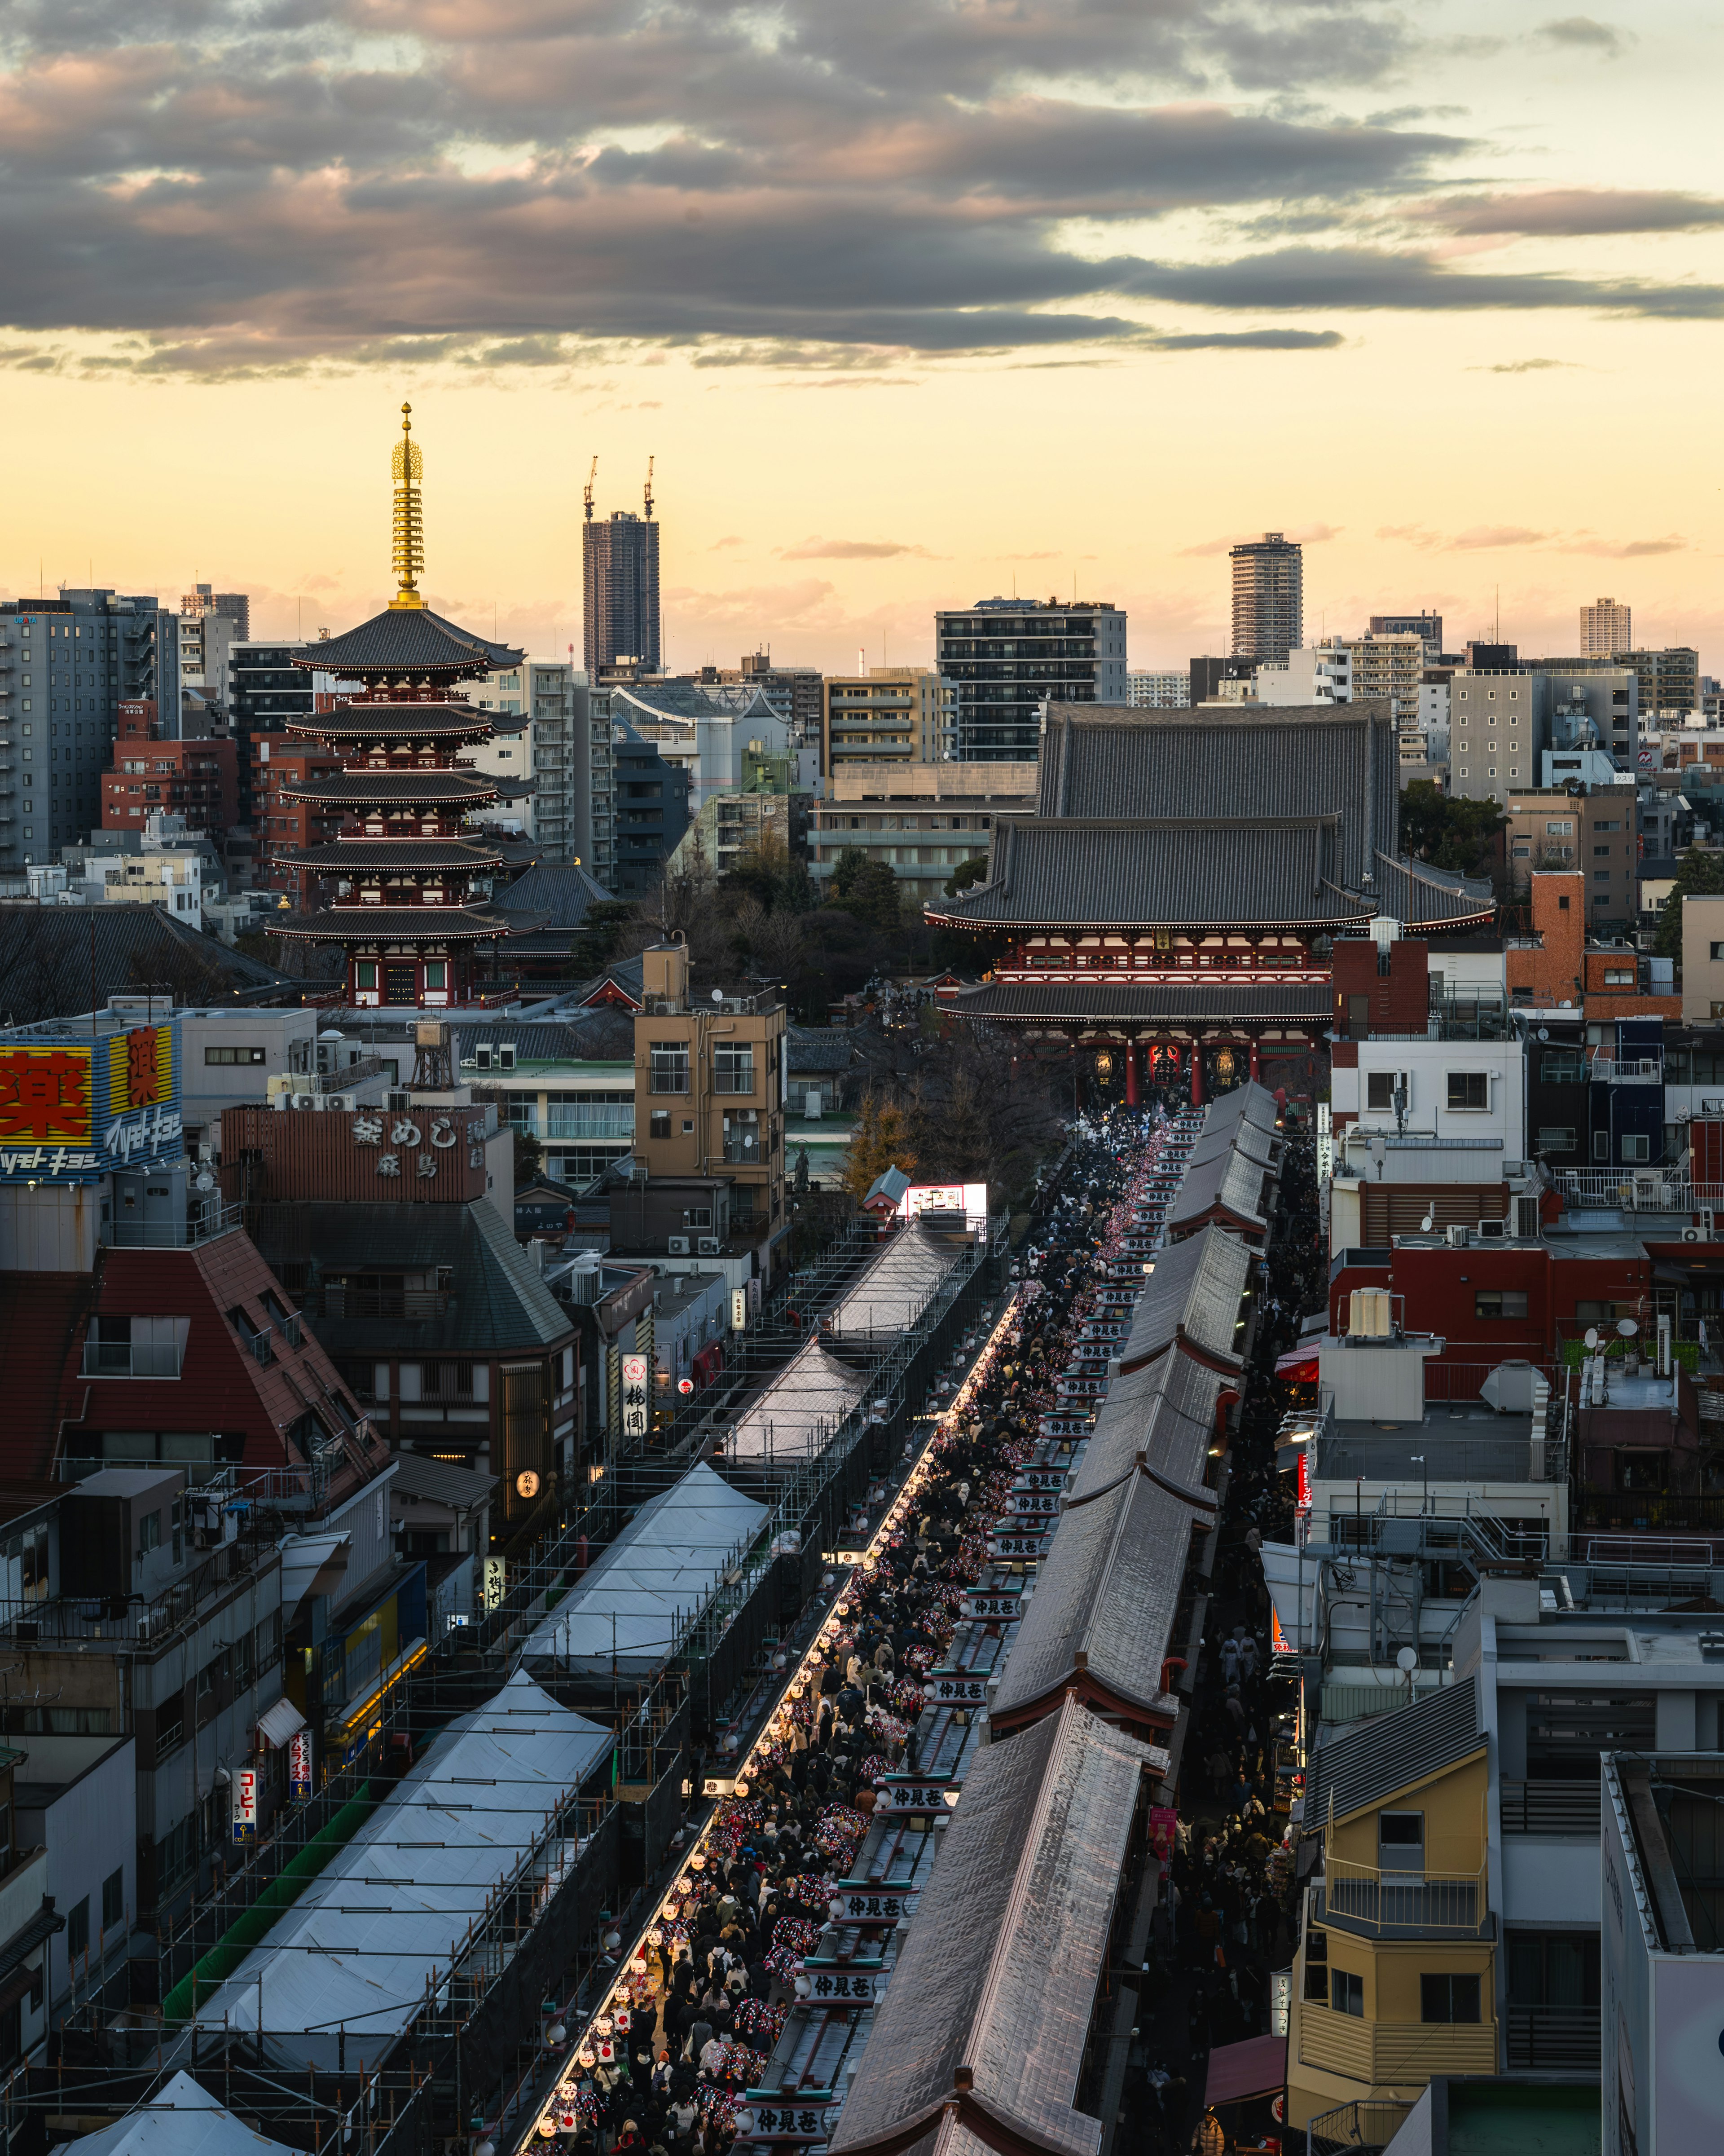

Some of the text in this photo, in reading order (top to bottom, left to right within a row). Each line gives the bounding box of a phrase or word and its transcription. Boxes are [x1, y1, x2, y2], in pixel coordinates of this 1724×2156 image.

[127, 1025, 158, 1107] 薬
[0, 1052, 87, 1137] 薬
[103, 1107, 183, 1164] マツモトキヨシ
[352, 1116, 457, 1148] 釜めし
[0, 1146, 101, 1176] ツモトキヨシ
[625, 1384, 645, 1429] 梅園
[291, 1733, 302, 1780] オムライス
[302, 1733, 310, 1780] とろとろ卵の
[241, 1773, 254, 1817] コーヒー
[1277, 1979, 1286, 2033] 浅草そらつき
